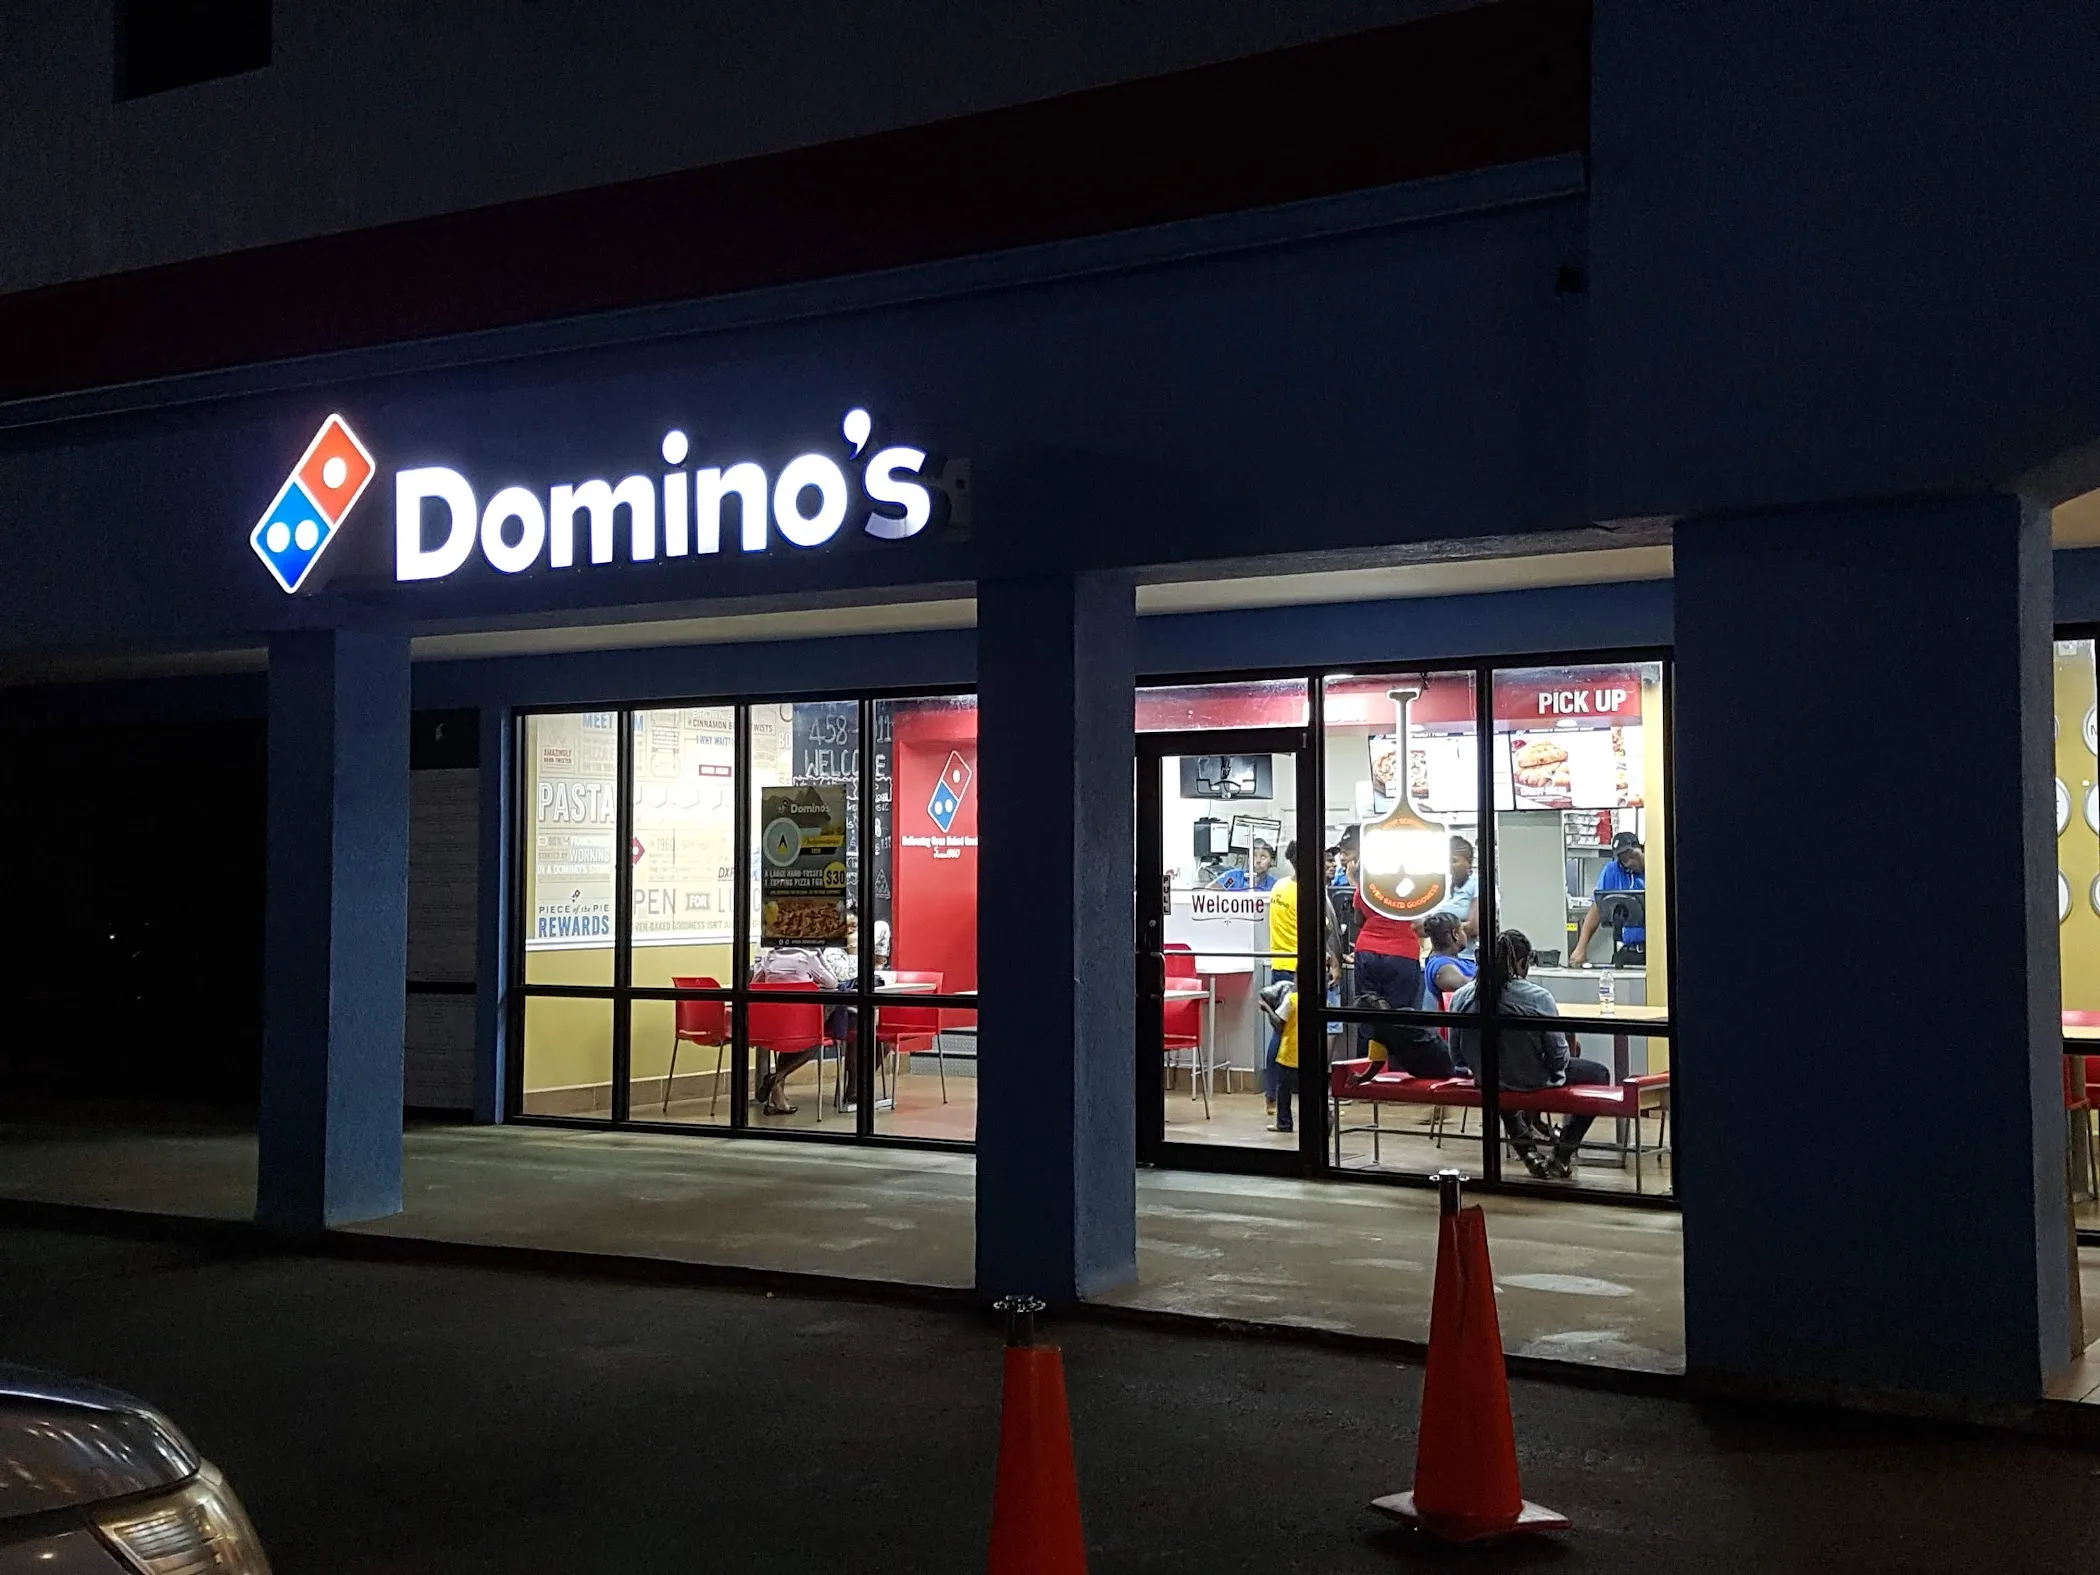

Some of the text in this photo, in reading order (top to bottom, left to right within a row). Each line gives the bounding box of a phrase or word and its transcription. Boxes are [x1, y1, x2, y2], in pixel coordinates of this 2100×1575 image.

[396, 408, 931, 581] Domino's
[1538, 689, 1627, 714] PICK UP
[583, 713, 614, 729] MEET
[693, 719, 727, 730] CINNAMON
[753, 723, 773, 733] WISTS
[805, 749, 886, 778] WELCOE
[538, 782, 615, 823] PASTA
[569, 847, 609, 864] WORKING
[794, 879, 810, 887] PIZZA
[827, 870, 845, 886] $30
[538, 905, 570, 914] PIECE
[593, 904, 609, 912] PIE
[633, 888, 676, 915] PEN
[688, 894, 708, 908] FOR
[1192, 894, 1264, 914] Welcome
[538, 915, 609, 938] REWARDS
